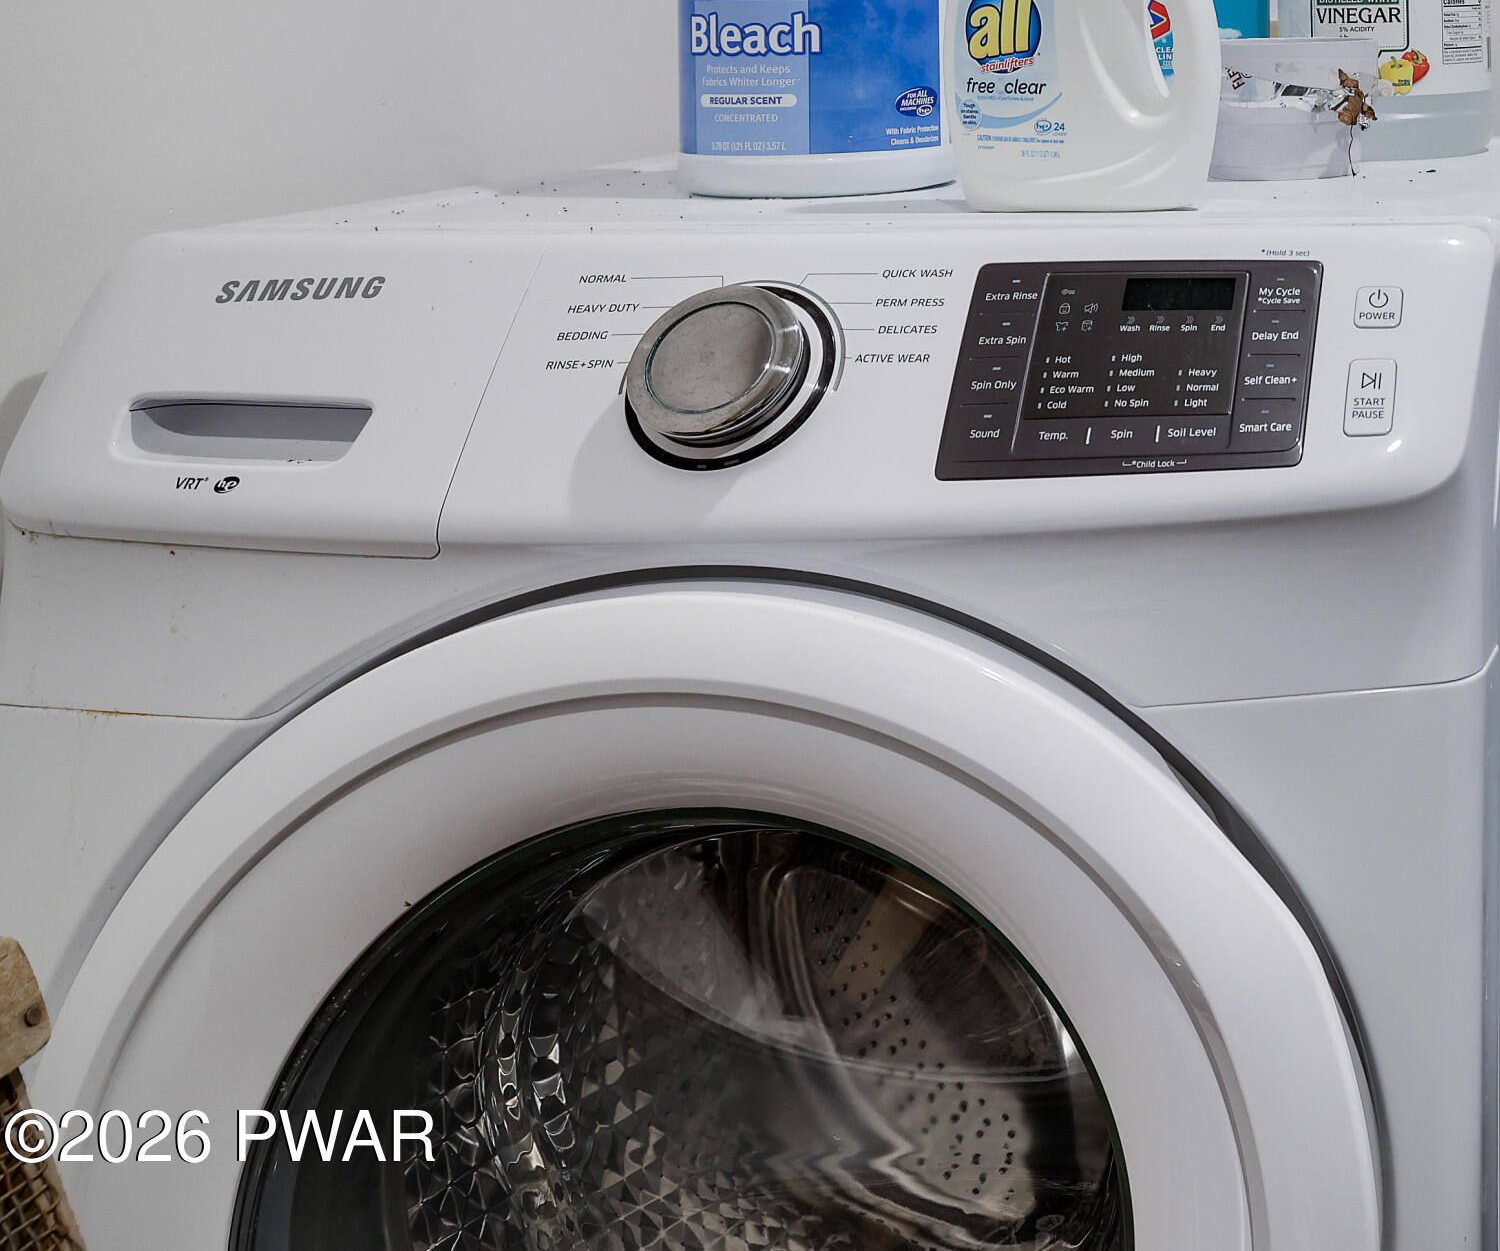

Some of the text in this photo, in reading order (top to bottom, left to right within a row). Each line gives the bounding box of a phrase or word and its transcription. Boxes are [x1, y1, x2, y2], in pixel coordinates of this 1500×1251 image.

[1316, 7, 1402, 24] VINEGAR
[690, 11, 822, 56] Bleach
[706, 64, 791, 75] Protects and Keeps
[980, 57, 1035, 73] stainlifters
[702, 77, 728, 87] Fabrics
[729, 77, 759, 87] Whiter
[966, 77, 1046, 94] free clear
[709, 96, 783, 105] REGULAR SCENT
[901, 96, 935, 107] MACHINES
[714, 113, 778, 123] CONCENTRATED
[1053, 122, 1065, 131] 24
[578, 274, 628, 284] NORMAL
[881, 269, 954, 279] QUICK WASH
[215, 276, 386, 304] SAMSUNG
[1259, 287, 1301, 297] My Cycle
[985, 291, 1038, 301] Extra Rinse
[875, 298, 945, 308] PERM PRESS
[567, 303, 641, 314] HEAVY DUTY
[1359, 311, 1395, 320] POWER
[877, 324, 938, 334] DELICATES
[1119, 324, 1226, 333] Wash Rinse Spin End
[556, 331, 609, 342] BEDDING
[978, 335, 1027, 346] Extra Spin
[1252, 331, 1299, 342] Delay End
[854, 353, 931, 364] ACTIVE WEAR
[1054, 356, 1071, 364] Hot
[1121, 354, 1143, 363] High
[1052, 370, 1079, 378] Warm
[1119, 368, 1155, 377] Medium
[1188, 368, 1217, 378] Heavy
[970, 380, 1017, 391] Spin Only
[1244, 376, 1263, 385] Self
[1049, 385, 1094, 394] Eco Warm
[1116, 384, 1135, 392] Low
[1186, 383, 1219, 391] Normal
[1047, 400, 1067, 409] Cold
[1114, 399, 1149, 408] No Spin
[1184, 398, 1208, 408] Light
[1353, 398, 1386, 406] START
[1352, 410, 1384, 419] PAUSE
[1167, 427, 1217, 437] Soil Level
[1239, 422, 1292, 433] Smart Care
[970, 428, 1000, 439] Sound
[1038, 431, 1069, 441] Temp.
[1110, 428, 1133, 440] Spin
[1157, 459, 1175, 468] Lock
